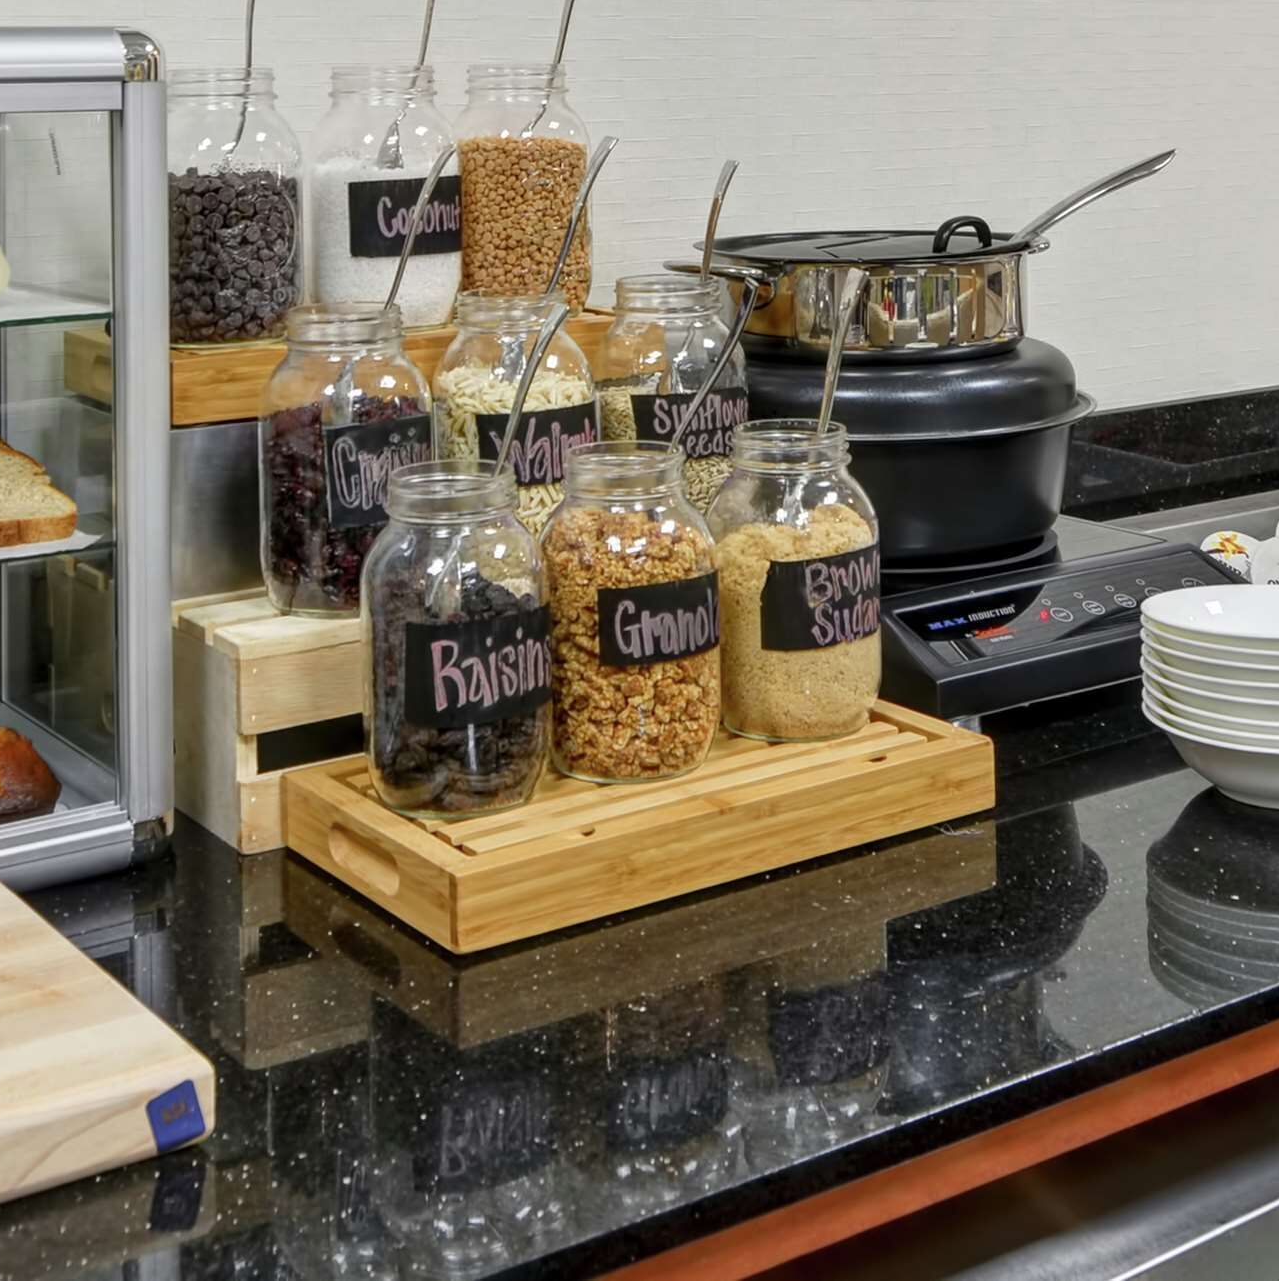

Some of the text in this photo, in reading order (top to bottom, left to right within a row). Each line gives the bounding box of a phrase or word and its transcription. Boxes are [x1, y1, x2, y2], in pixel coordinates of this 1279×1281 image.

[682, 429, 735, 458] eeds
[927, 617, 968, 631] MAX
[431, 626, 552, 712] Raisins
